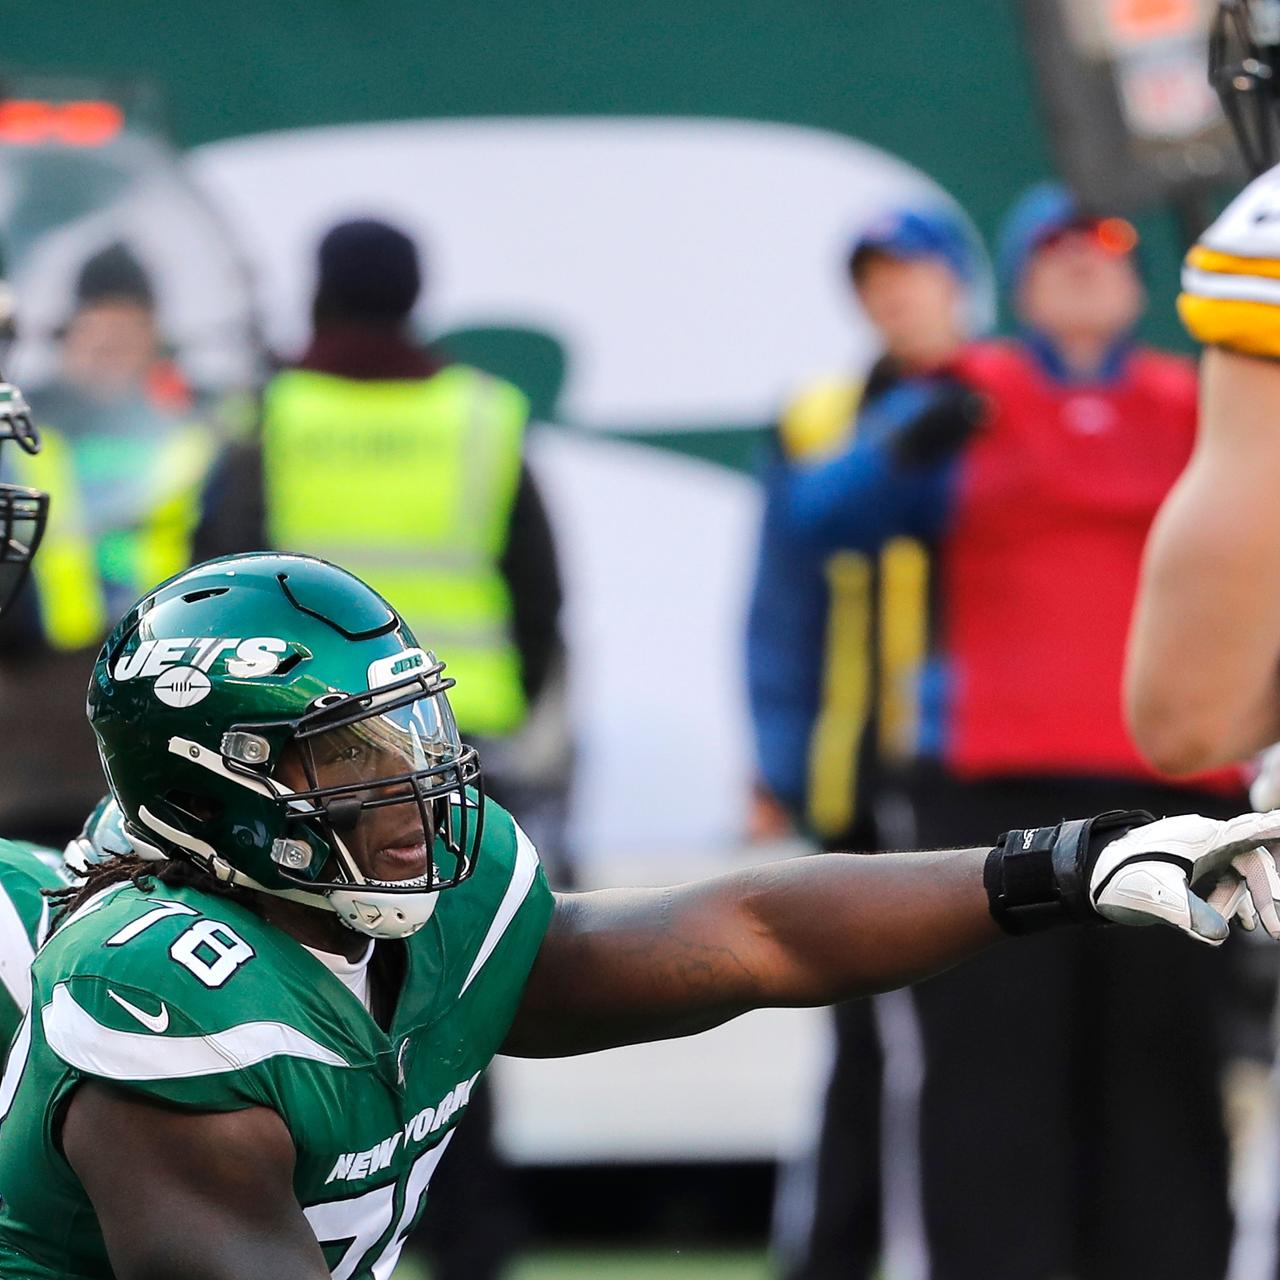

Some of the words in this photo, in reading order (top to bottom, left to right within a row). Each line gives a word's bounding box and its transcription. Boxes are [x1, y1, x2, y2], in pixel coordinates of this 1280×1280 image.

[113, 637, 287, 681] JETS
[391, 654, 423, 675] JETS
[102, 897, 256, 990] 78
[324, 1131, 403, 1185] NEW
